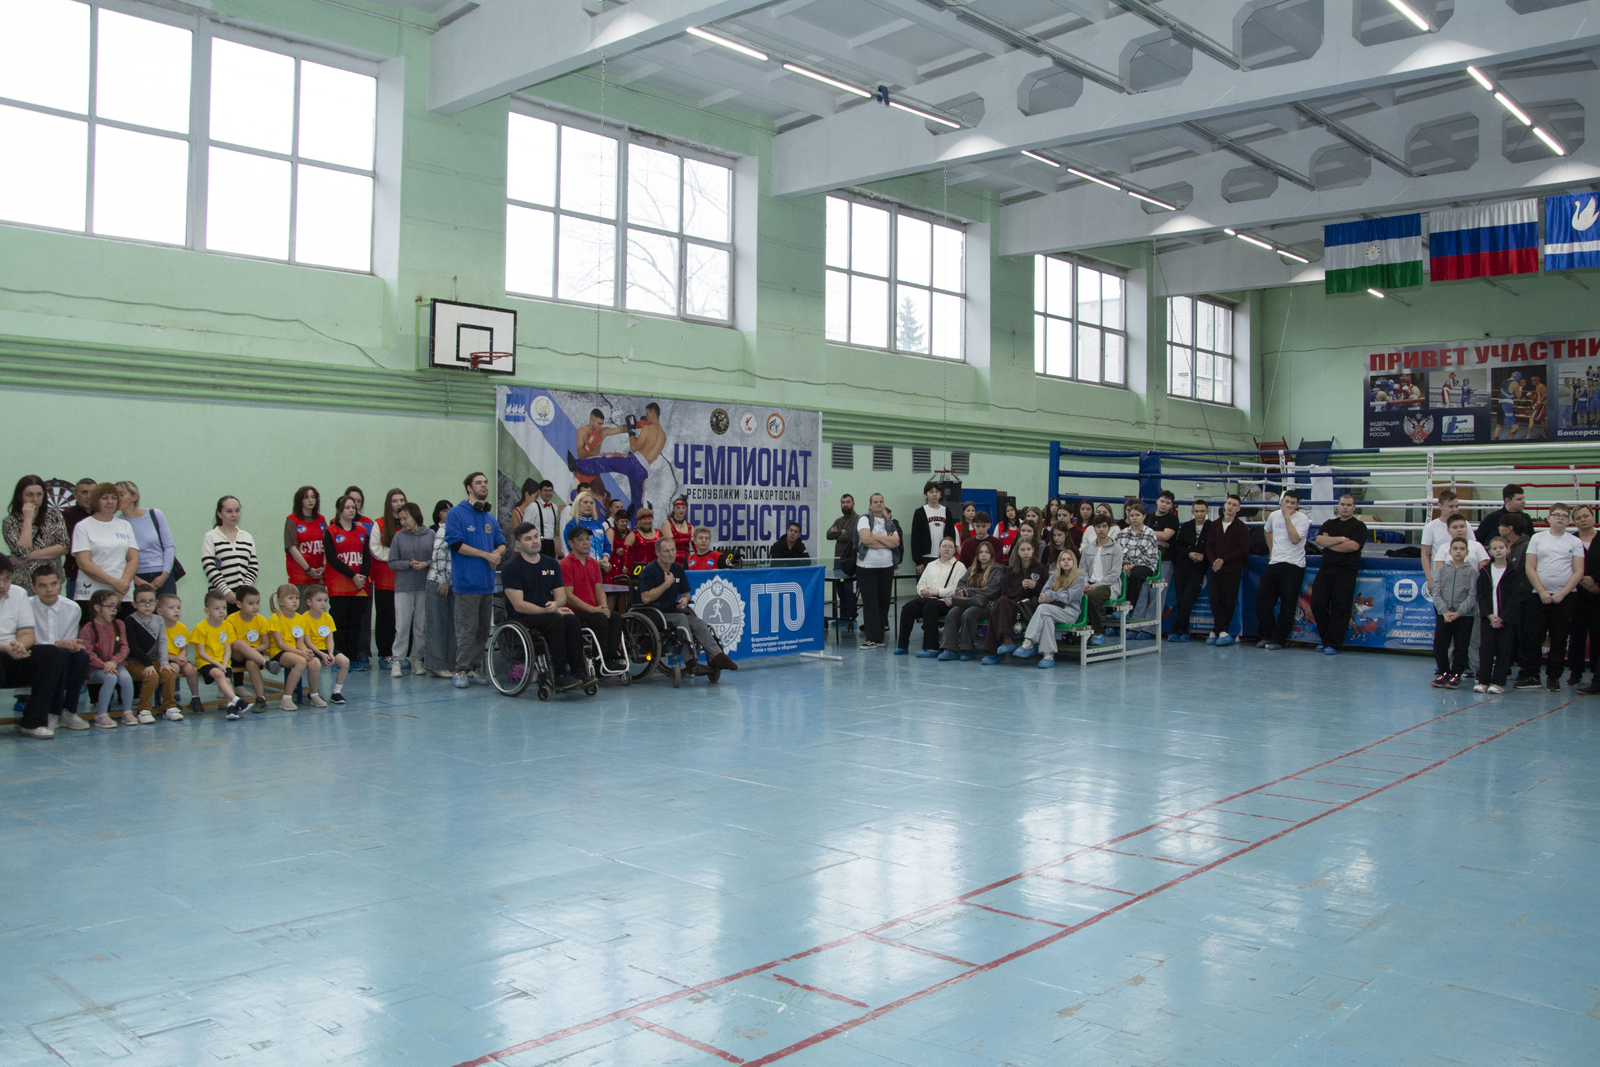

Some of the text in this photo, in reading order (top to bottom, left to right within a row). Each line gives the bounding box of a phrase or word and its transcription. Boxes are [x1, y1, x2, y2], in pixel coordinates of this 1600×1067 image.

[1370, 347, 1469, 371] ПРИВЕТ
[1557, 429, 1600, 437] Боксерск
[674, 443, 812, 488] ЧЕМПИОНАТ
[687, 488, 801, 501] РЕСПУБЛИКИ БАШКОРТОСТАН
[299, 540, 325, 555] СУД
[337, 551, 363, 566] СУДЬ
[633, 565, 642, 576] 0
[749, 581, 805, 635] ГТО
[1392, 630, 1433, 639] ПОДТЯНИСЬ
